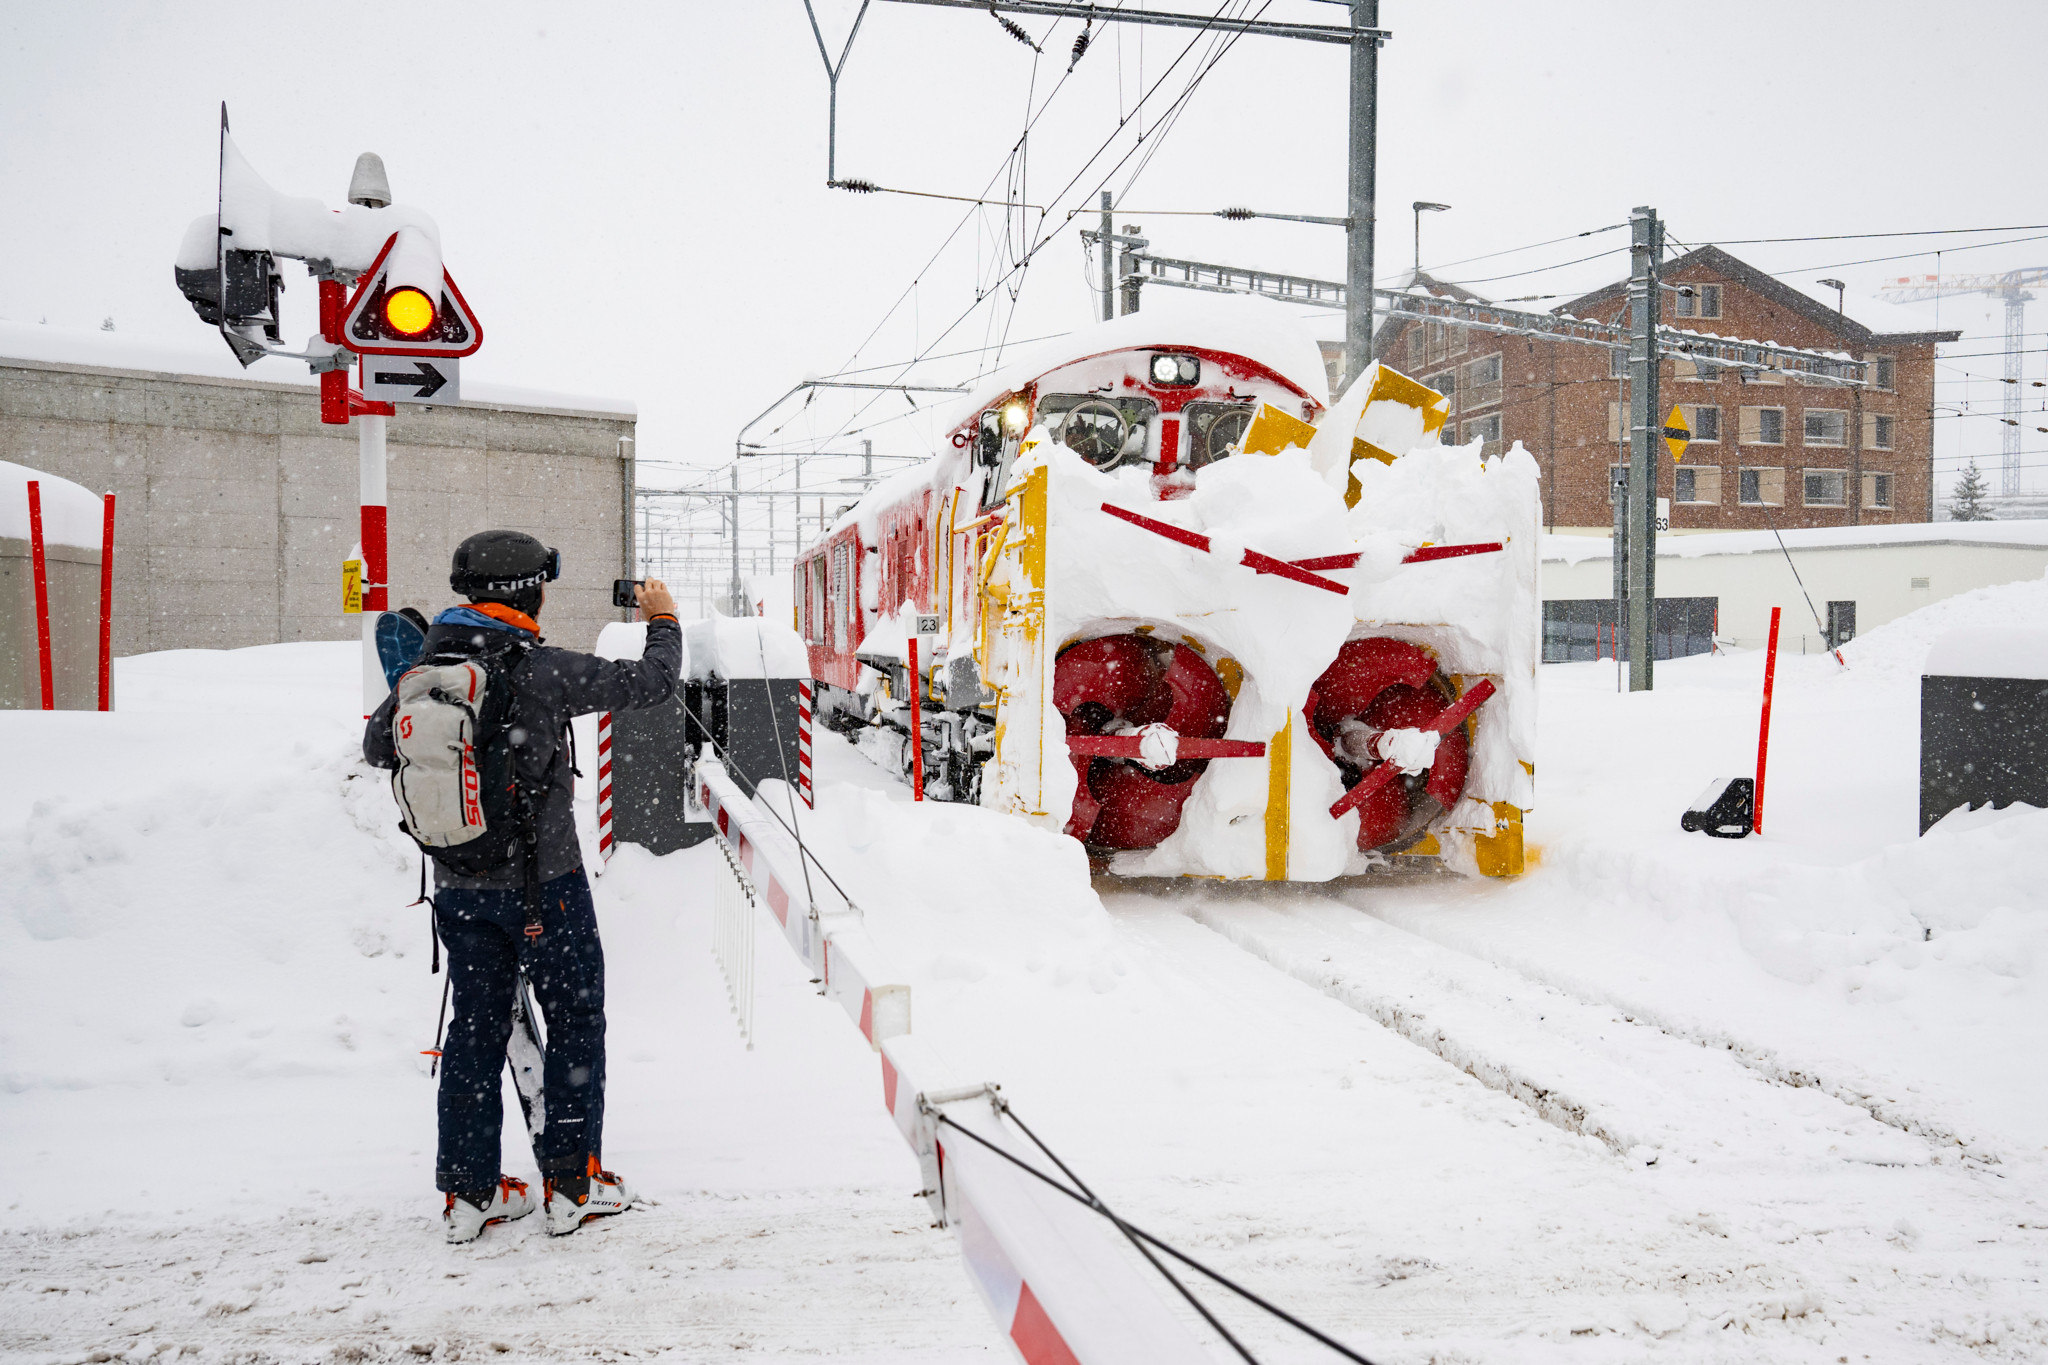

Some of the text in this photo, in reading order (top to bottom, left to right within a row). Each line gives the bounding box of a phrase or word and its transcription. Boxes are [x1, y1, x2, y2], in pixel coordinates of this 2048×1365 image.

[443, 325, 460, 334] S4.1
[488, 570, 548, 591] GIRO
[921, 619, 936, 631] 23
[463, 738, 483, 827] SCOTT
